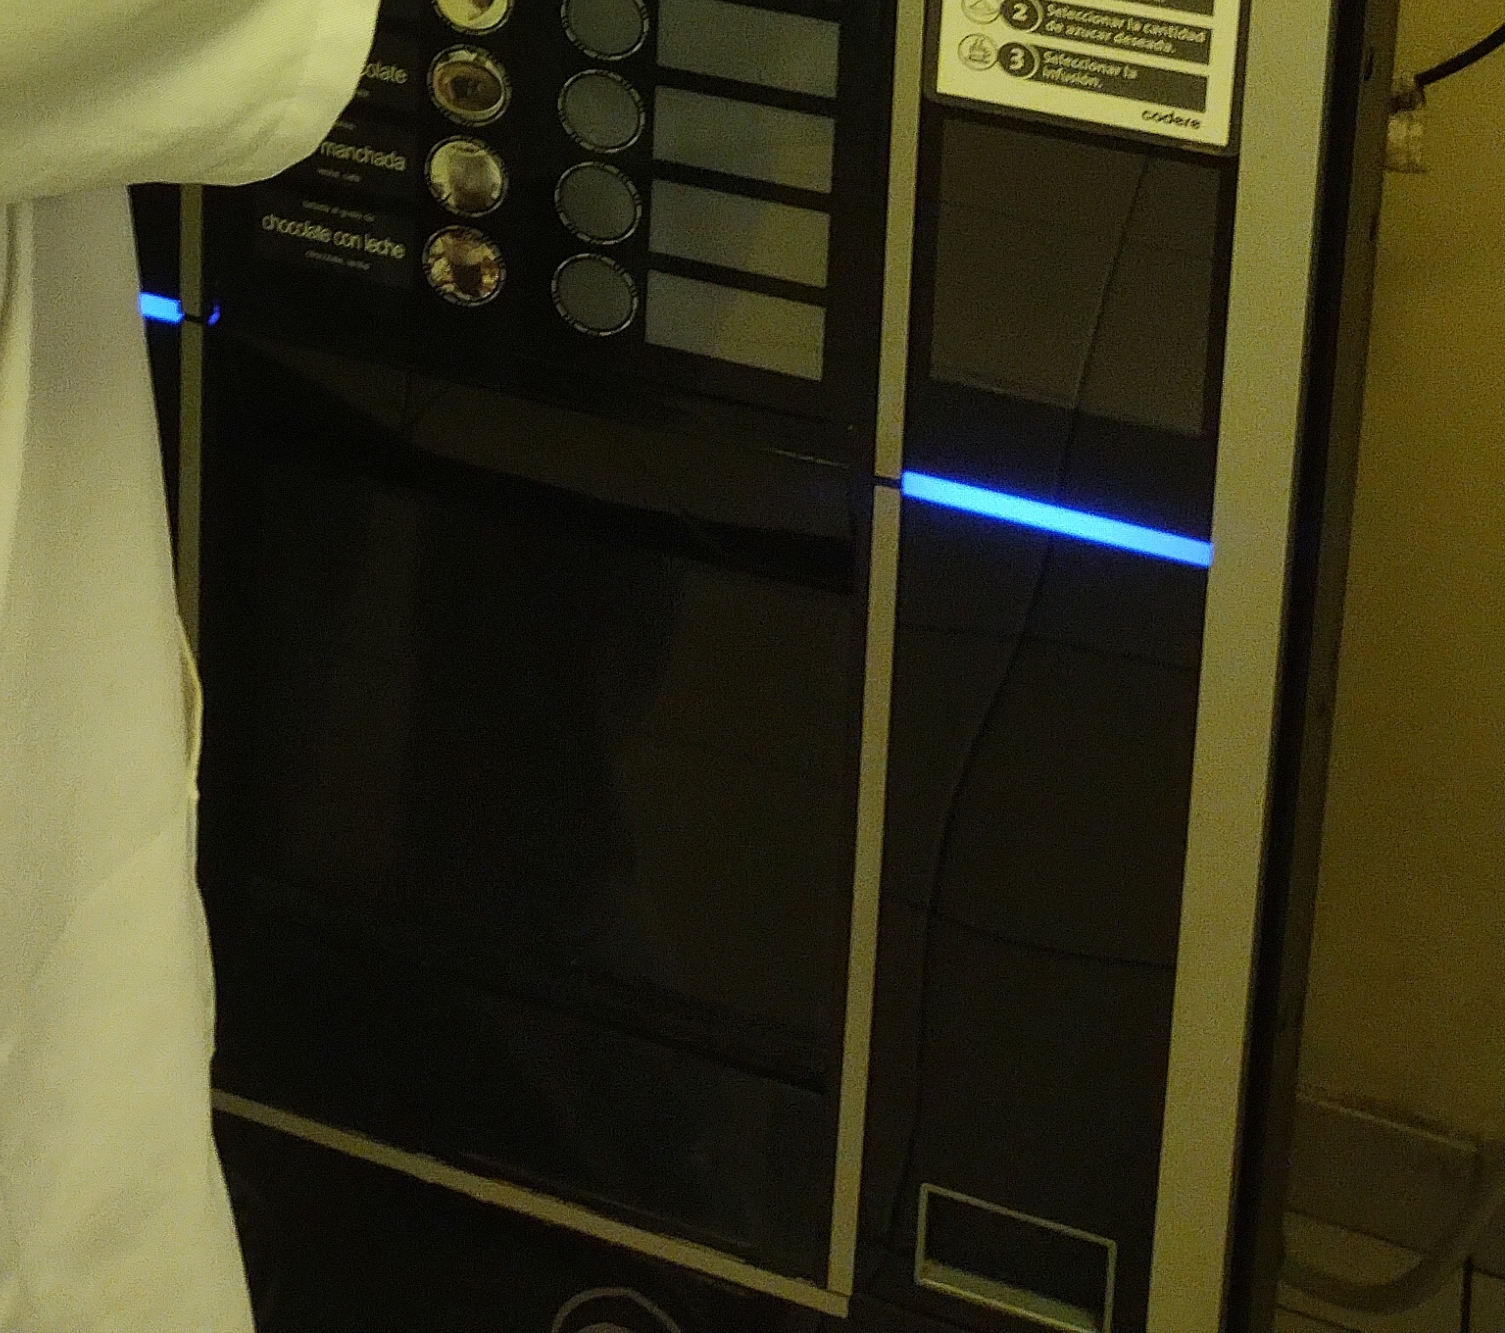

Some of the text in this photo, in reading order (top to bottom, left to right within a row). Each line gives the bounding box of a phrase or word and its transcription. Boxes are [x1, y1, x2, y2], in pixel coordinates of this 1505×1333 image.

[1012, 2, 1028, 21] 2
[1008, 50, 1025, 70] 3
[362, 61, 409, 84] olate
[1140, 108, 1203, 130] codere
[320, 139, 408, 173] manchada
[261, 213, 332, 244] chocolate
[332, 229, 363, 251] con
[363, 232, 407, 260] leche
